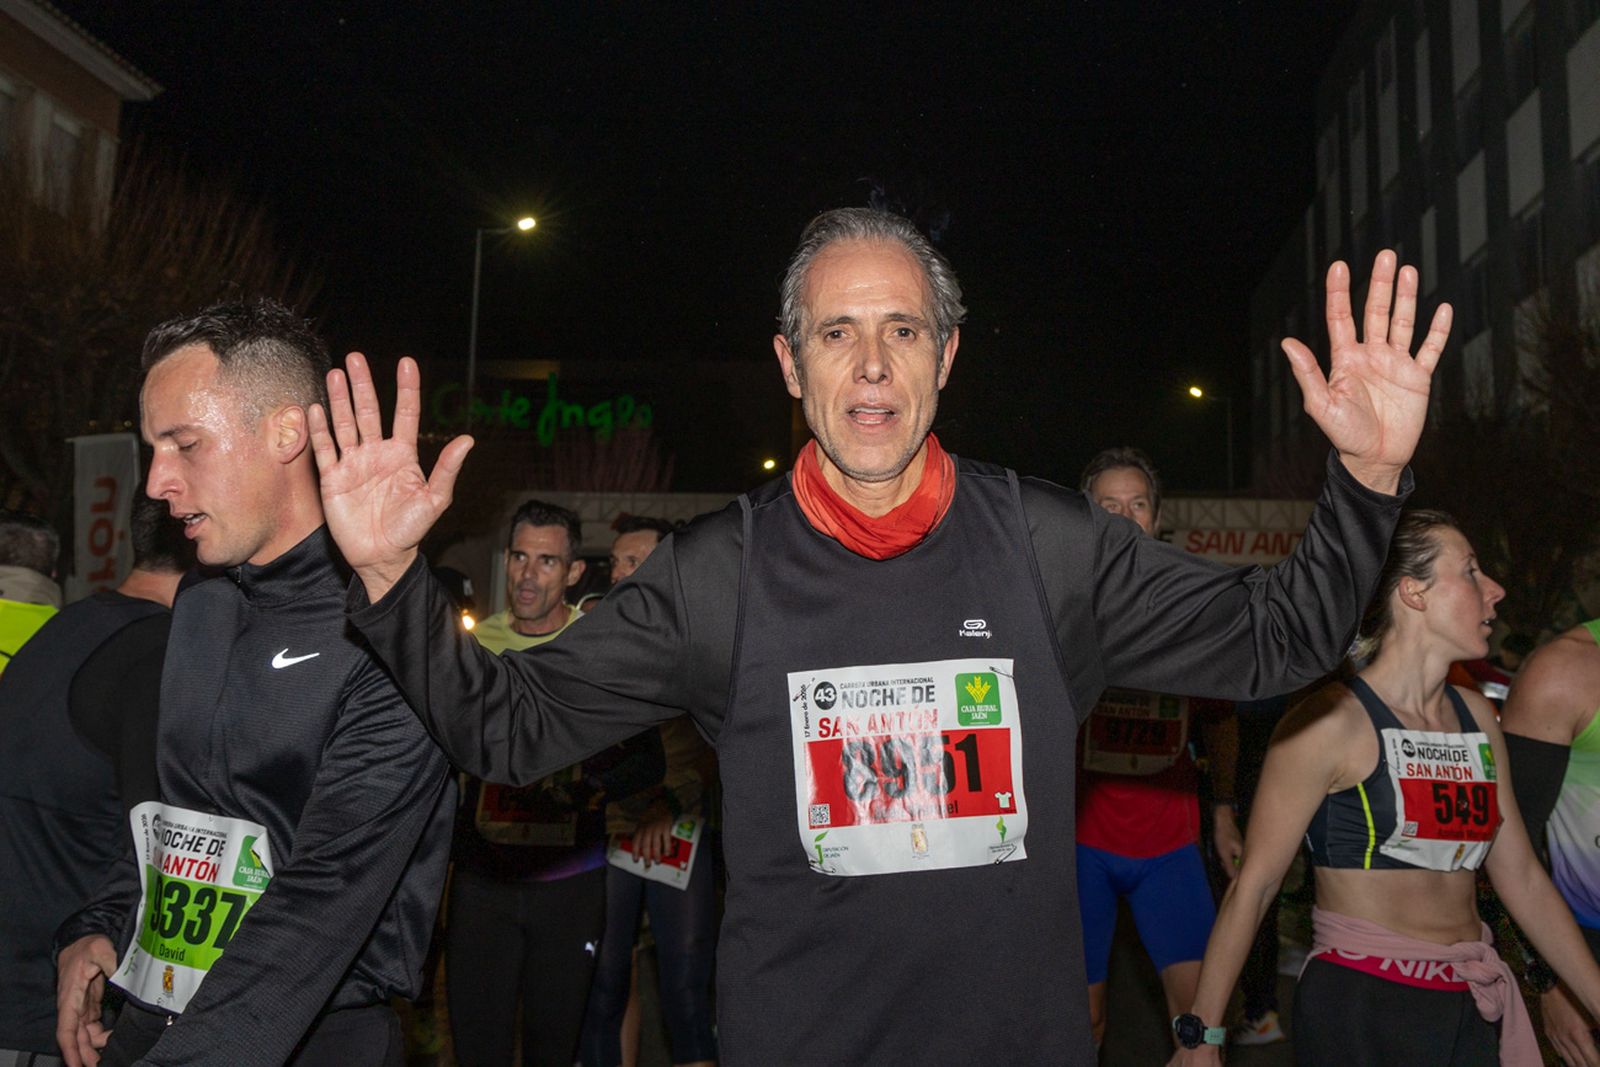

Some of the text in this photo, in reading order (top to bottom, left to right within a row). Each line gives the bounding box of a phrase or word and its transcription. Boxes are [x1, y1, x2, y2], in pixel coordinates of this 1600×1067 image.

[1185, 529, 1245, 555] SAN
[815, 687, 836, 703] 43
[841, 685, 935, 709] NOCHE DE
[818, 704, 938, 738] SAN ANTÓN
[842, 733, 983, 802] 8951
[1453, 750, 1469, 763] DE
[1406, 763, 1432, 778] SAN
[1436, 763, 1473, 781] ANTÓN
[1432, 783, 1489, 826] 549
[206, 838, 226, 857] DE
[162, 853, 221, 883] ANTÓN
[150, 874, 247, 951] 9337
[159, 943, 185, 962] David
